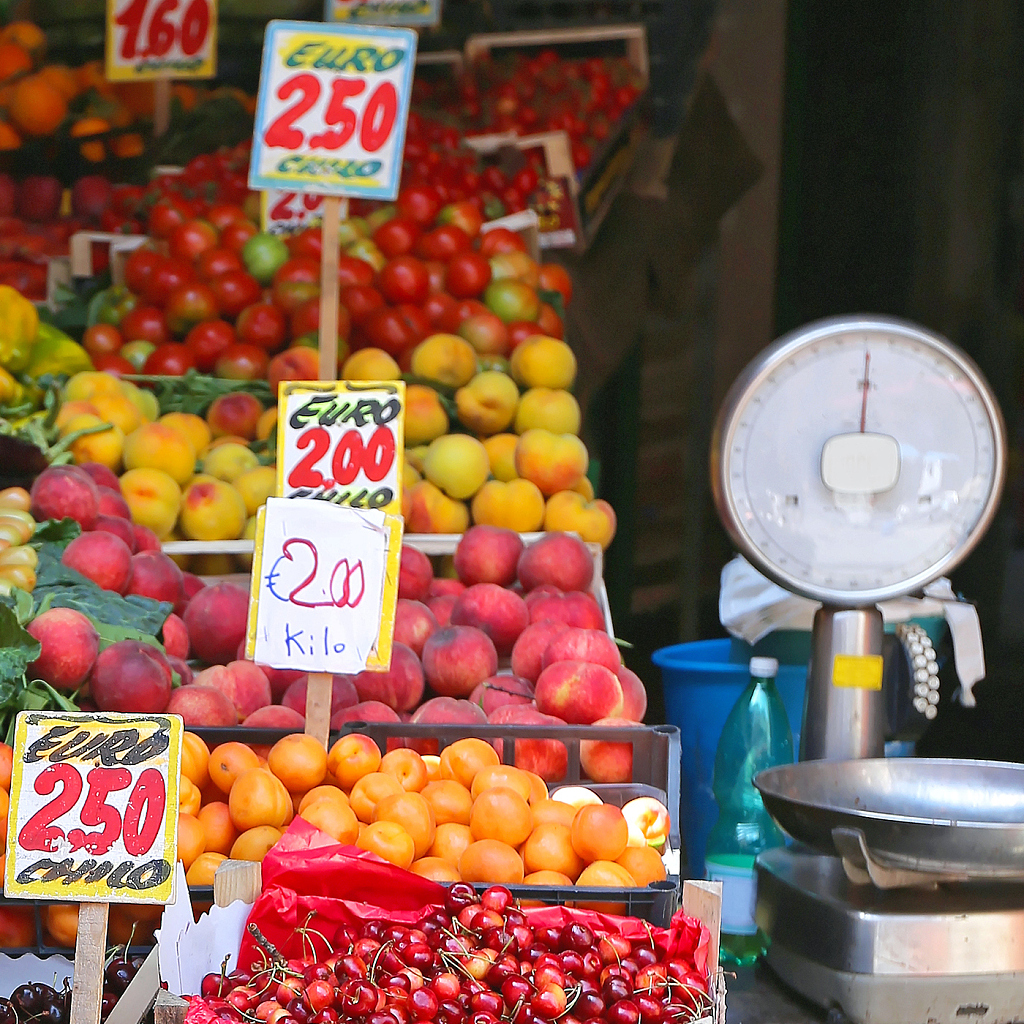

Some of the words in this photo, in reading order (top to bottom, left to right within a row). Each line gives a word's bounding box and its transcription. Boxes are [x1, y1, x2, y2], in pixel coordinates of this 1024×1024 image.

[286, 41, 405, 72] EURO
[289, 395, 402, 430] EURO
[284, 623, 346, 657] Kilo
[22, 725, 170, 767] EURO
